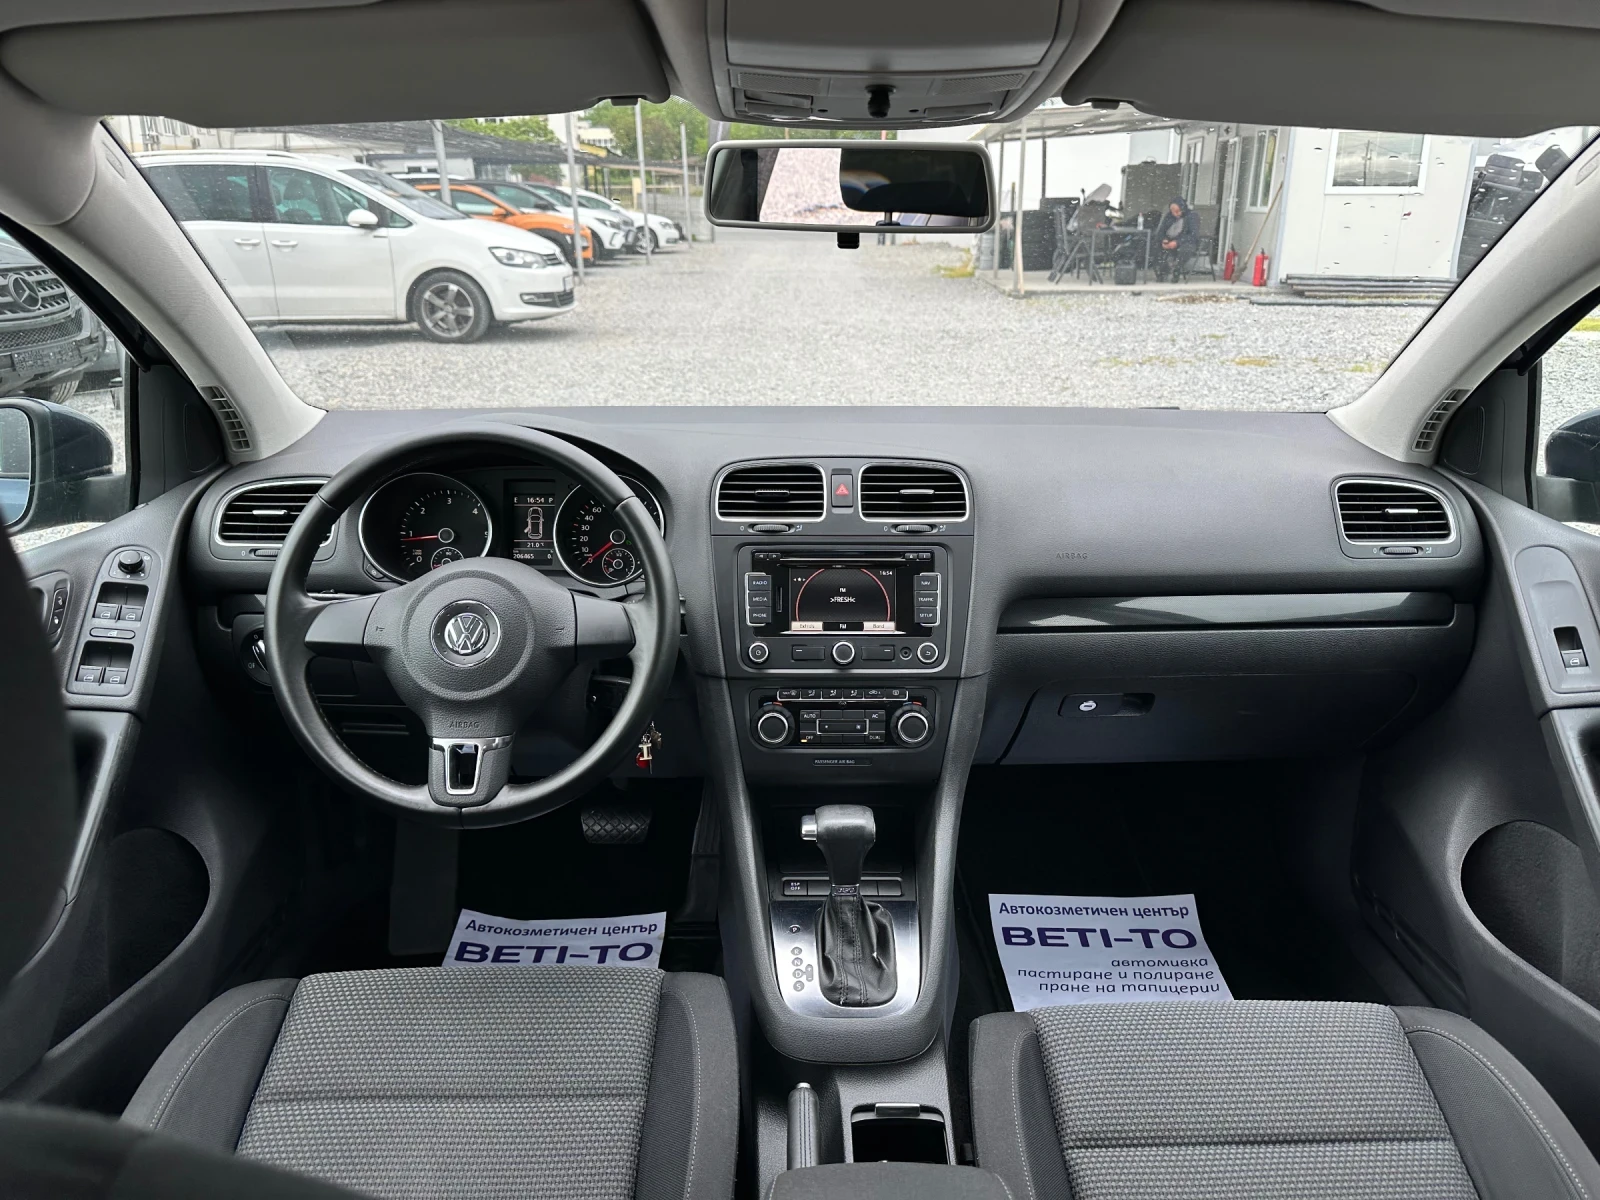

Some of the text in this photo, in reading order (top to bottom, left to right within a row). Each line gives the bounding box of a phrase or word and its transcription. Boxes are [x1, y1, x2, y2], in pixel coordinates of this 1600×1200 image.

[449, 721, 480, 729] AIRBAG
[999, 902, 1189, 919] Автокозметичен център
[465, 919, 658, 937] Автокозметичен център
[1002, 926, 1197, 949] BETI-TO
[454, 941, 654, 964] BETI-TO
[1111, 958, 1208, 967] автомивка
[1018, 968, 1113, 981] пастиране
[1133, 971, 1214, 981] полиране
[1039, 982, 1220, 995] пране на тапицерии
